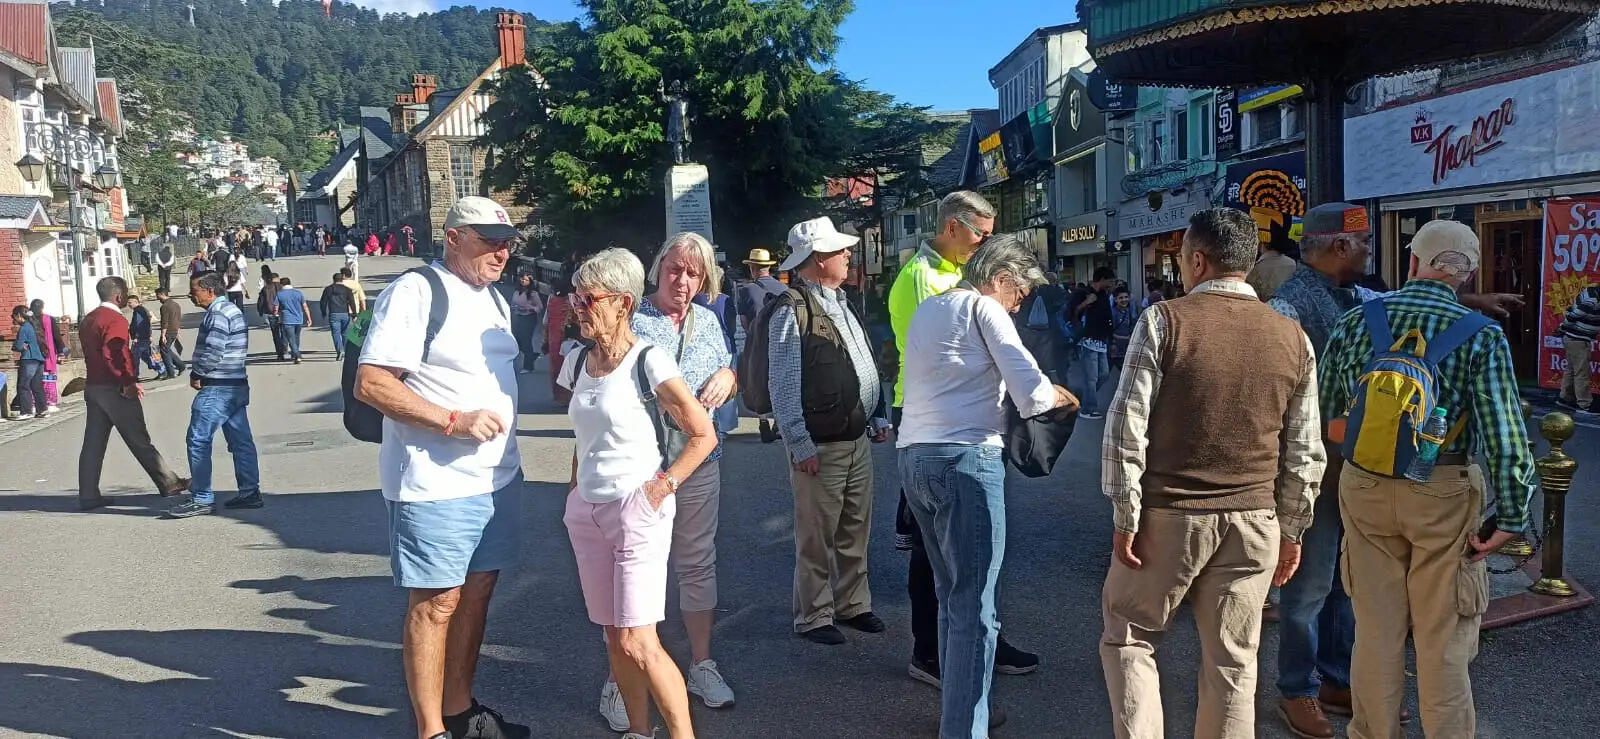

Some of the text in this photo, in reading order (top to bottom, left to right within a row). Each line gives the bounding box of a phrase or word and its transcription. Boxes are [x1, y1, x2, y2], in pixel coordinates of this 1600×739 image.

[1424, 98, 1514, 185] Thapar
[1062, 225, 1096, 243] ALLEN SOLLY
